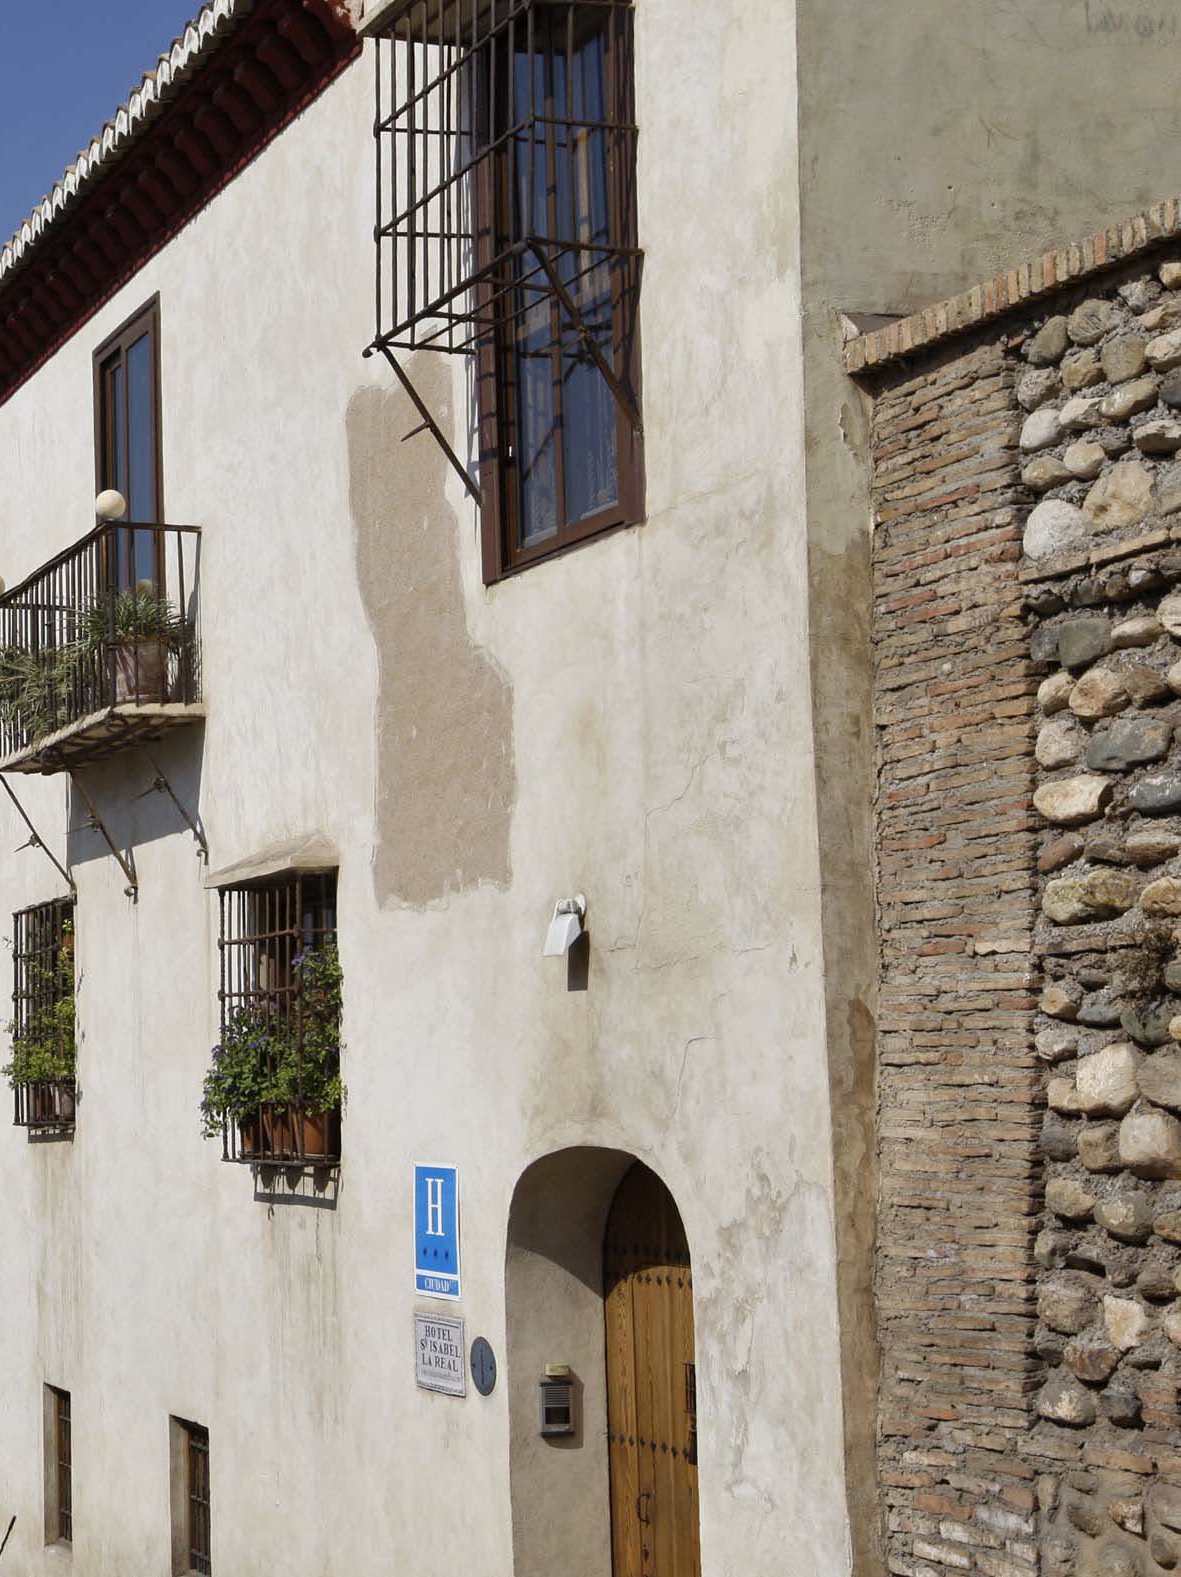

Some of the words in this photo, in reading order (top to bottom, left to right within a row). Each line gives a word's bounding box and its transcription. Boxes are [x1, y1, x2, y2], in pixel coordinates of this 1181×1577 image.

[425, 1177, 445, 1236] H
[424, 1278, 450, 1292] CIUDAD
[425, 1325, 452, 1341] HOTEL
[429, 1340, 460, 1358] ISABEL
[422, 1352, 432, 1366] LA
[435, 1355, 458, 1372] REAL
